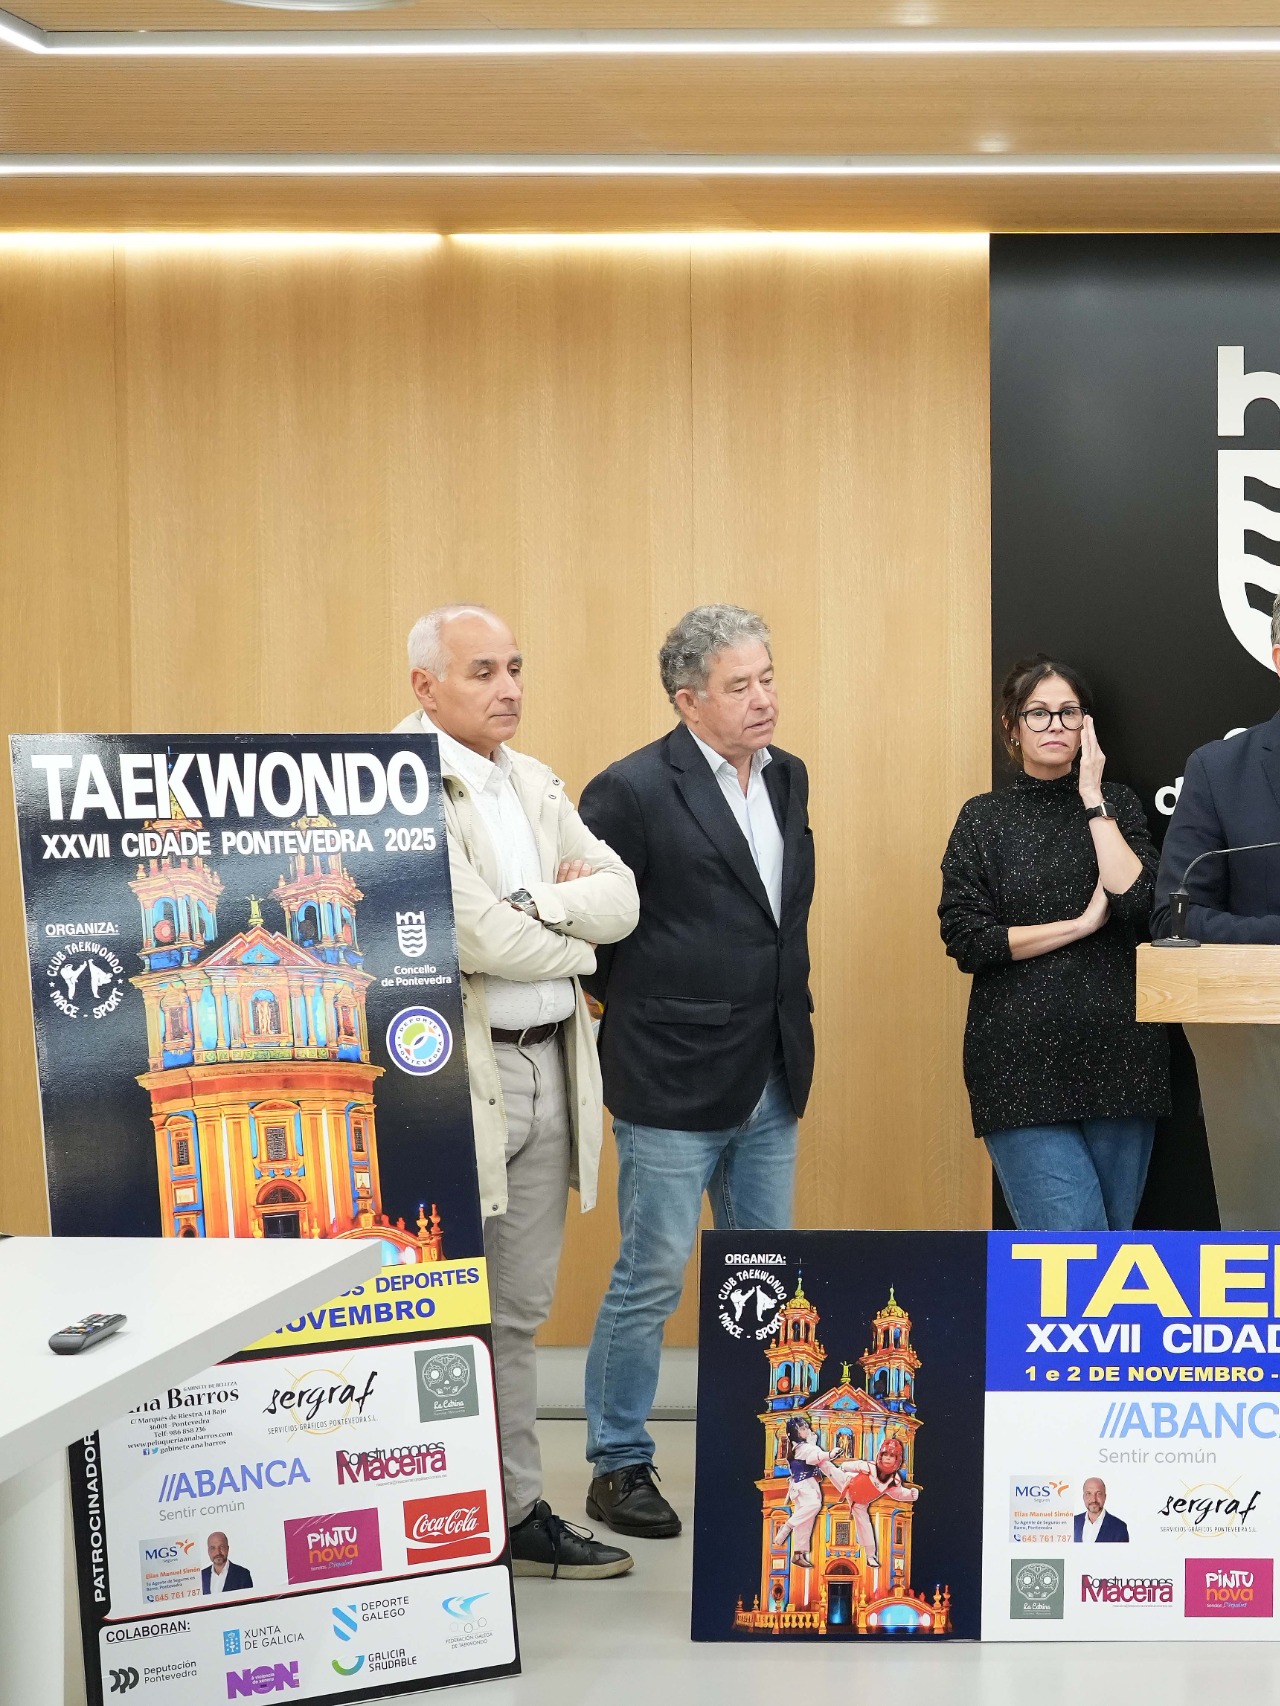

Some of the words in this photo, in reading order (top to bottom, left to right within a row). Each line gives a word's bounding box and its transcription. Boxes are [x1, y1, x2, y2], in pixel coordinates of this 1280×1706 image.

[31, 750, 430, 821] TAEKWONDO
[41, 833, 111, 860] XXVII
[122, 830, 212, 857] CIDADE
[222, 829, 375, 855] PONTEVEDRA
[384, 827, 437, 852] 2025
[45, 922, 120, 936] ORGANIZA:
[47, 951, 66, 977] CLUB
[64, 941, 124, 974] TAEKWONDO
[394, 964, 437, 975] Concello
[381, 978, 394, 987] de
[395, 974, 452, 987] Pontevedra
[50, 990, 79, 1018] MACE
[92, 987, 124, 1019] SPORT
[725, 1253, 787, 1265] ORGANIZA:
[375, 1267, 480, 1294] DEPORTES
[718, 1276, 737, 1300] CLUB
[736, 1268, 787, 1300] TAEKWONDO
[274, 1298, 436, 1334] OVEMBRO
[719, 1312, 744, 1339] MACE
[755, 1313, 786, 1341] SPORT
[1025, 1323, 1140, 1354] XXVII
[1025, 1366, 1036, 1381] 1
[1046, 1369, 1060, 1382] e
[1067, 1366, 1080, 1381] 2
[1089, 1366, 1121, 1382] DE
[1128, 1366, 1264, 1383] NOVEMBRO
[167, 1388, 240, 1410] Barros
[262, 1371, 378, 1422] sergraf
[172, 1418, 210, 1429] Pontevedra
[1098, 1447, 1149, 1465] Sentir
[1154, 1447, 1217, 1465] común
[336, 1449, 447, 1485] Maceira
[1015, 1486, 1051, 1498] MGS
[84, 1430, 106, 1602] PATROCINADOR
[159, 1504, 198, 1522] Sentir
[202, 1500, 245, 1518] común
[1157, 1490, 1261, 1525] sergraf
[1022, 1534, 1037, 1543] 645
[1040, 1534, 1054, 1543] 761
[1057, 1534, 1072, 1543] 787
[145, 1546, 178, 1560] MGS
[309, 1544, 359, 1564] nova
[154, 1591, 169, 1602] 645
[171, 1589, 185, 1600] 761
[187, 1588, 200, 1597] 787
[361, 1596, 410, 1612] DEPORTE
[1206, 1588, 1254, 1601] nova
[362, 1607, 406, 1622] GALEGO
[106, 1619, 191, 1643] COLABORAN:
[244, 1625, 281, 1639] XUNTA
[244, 1638, 259, 1651] DE
[261, 1632, 305, 1648] GALICIA
[368, 1648, 406, 1663] GALICIA
[369, 1655, 418, 1673] SAUDABLE
[143, 1659, 197, 1678] Deputación
[144, 1668, 197, 1685] Pontevedra
